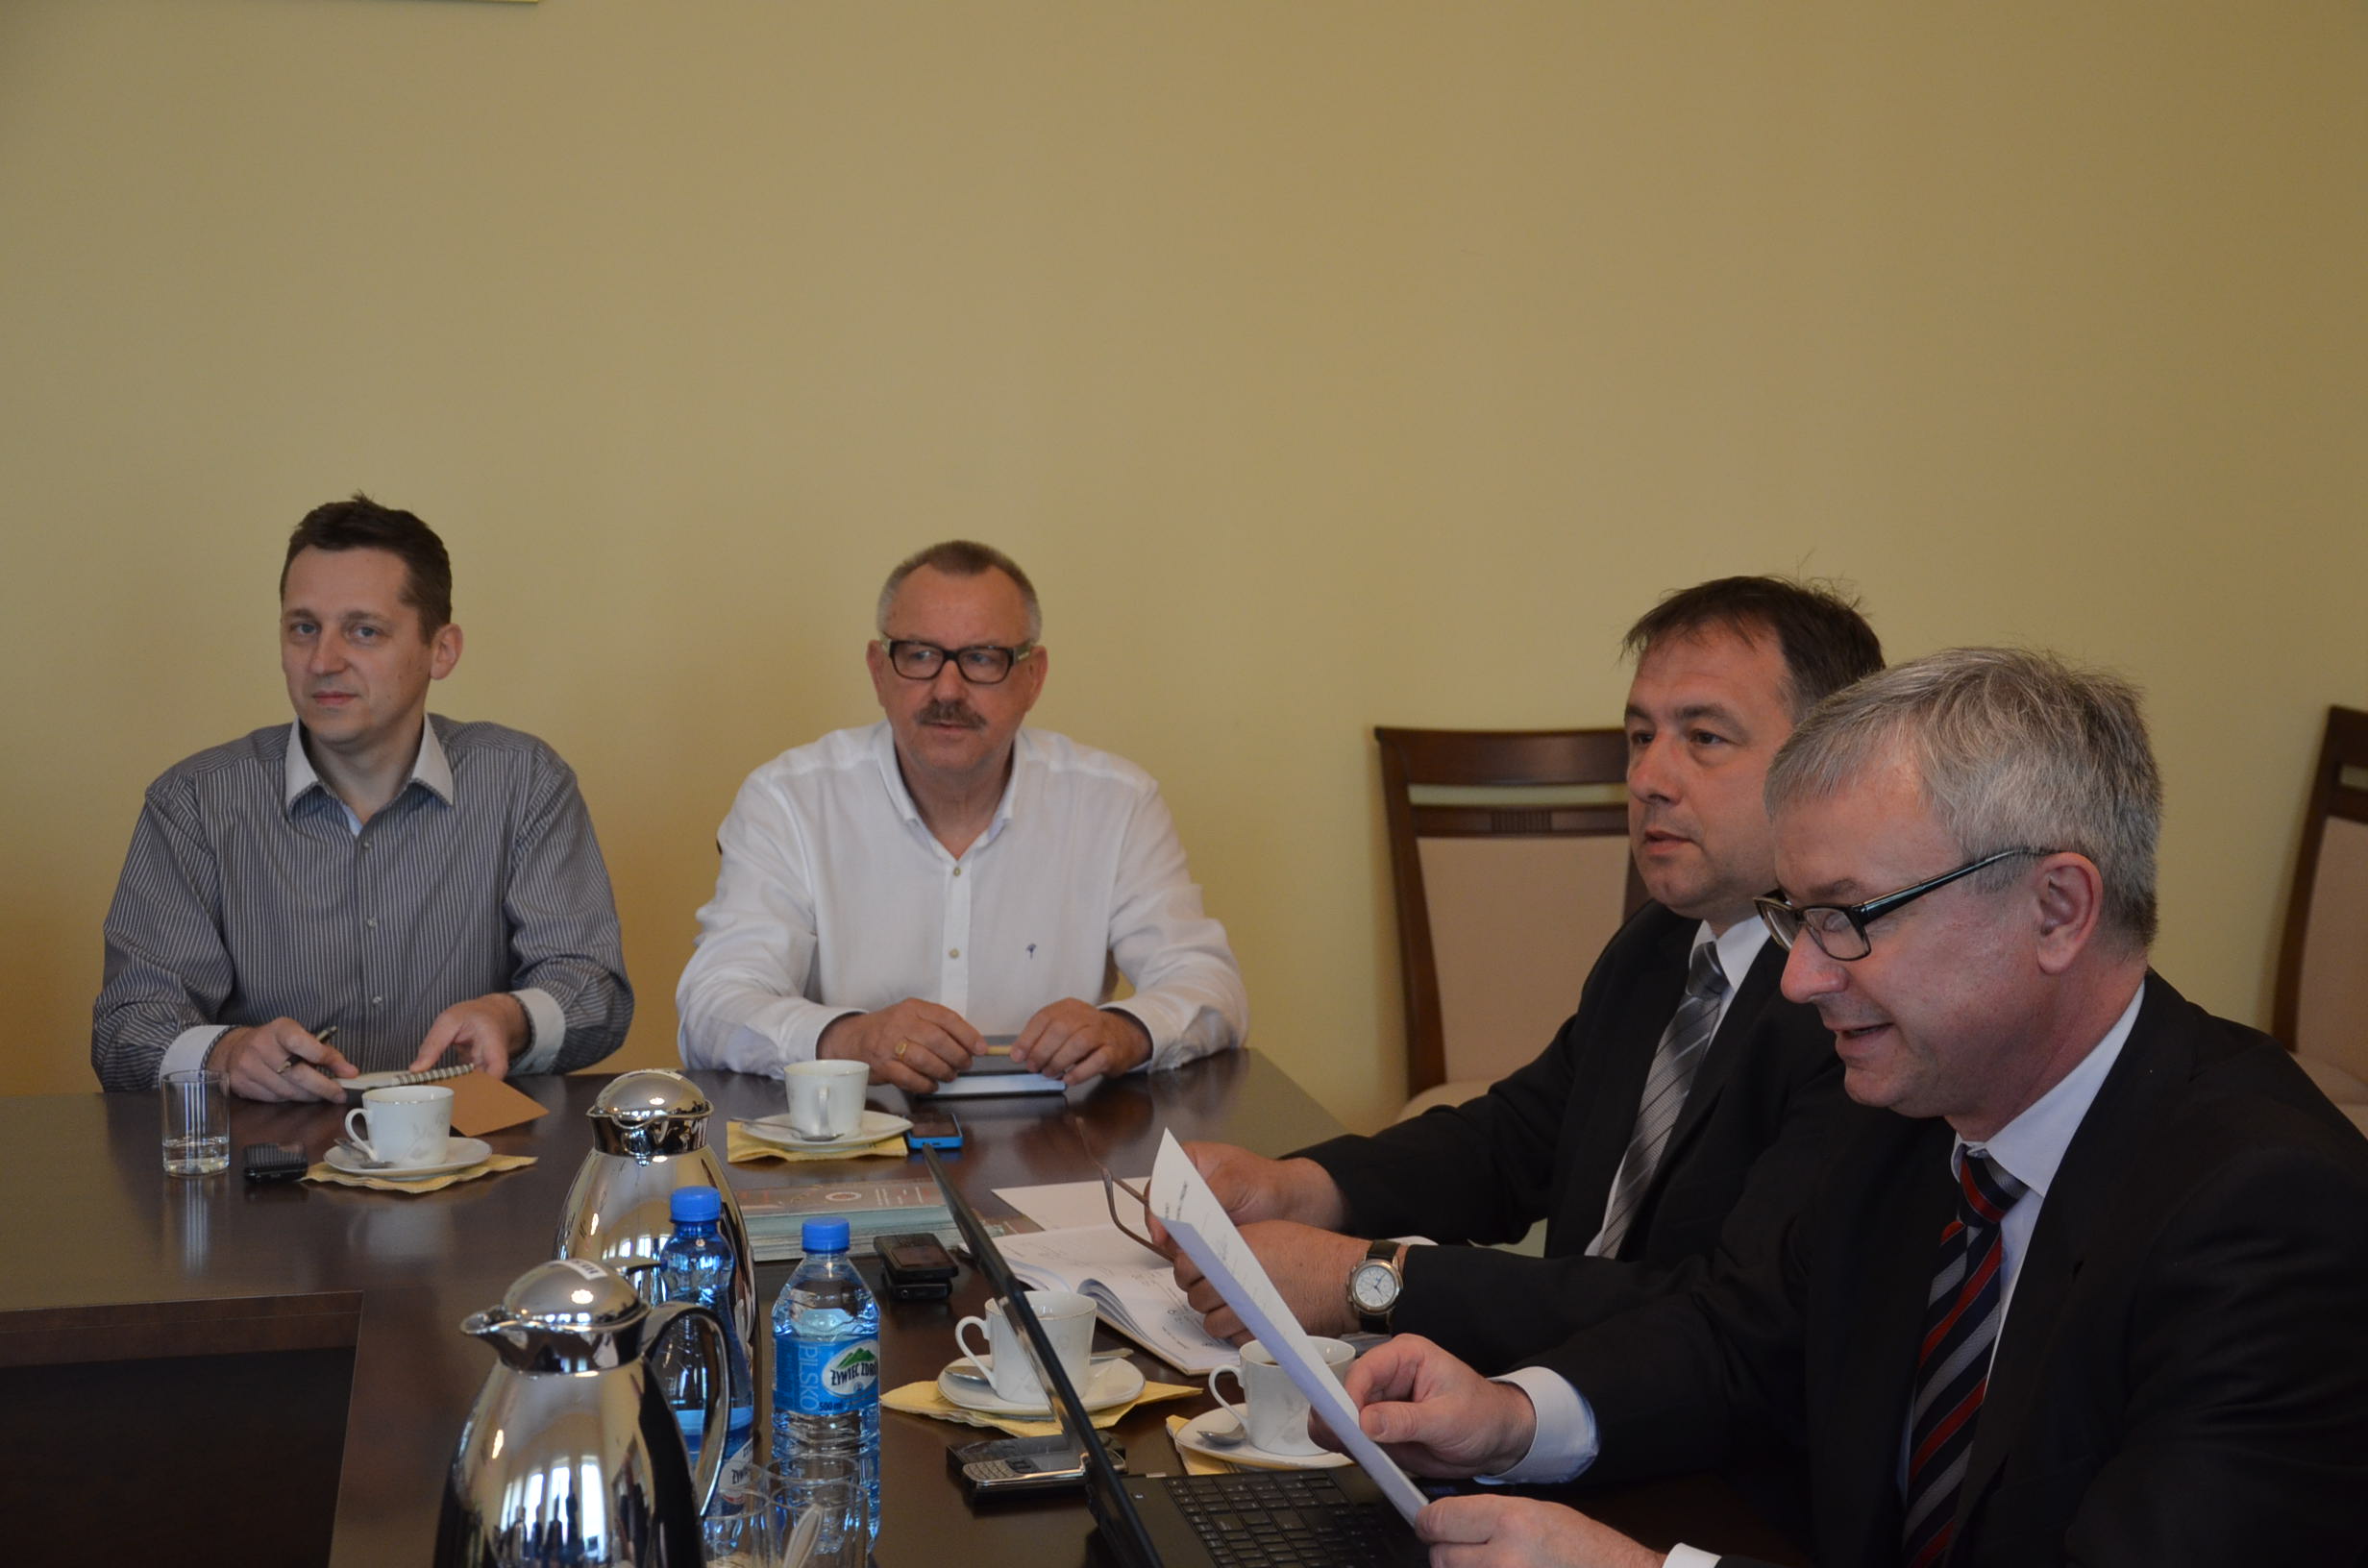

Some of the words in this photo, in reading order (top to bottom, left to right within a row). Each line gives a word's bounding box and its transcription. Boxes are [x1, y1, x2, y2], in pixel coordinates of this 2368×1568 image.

[800, 1345, 819, 1411] PILSKO
[830, 1364, 859, 1385] ŻYWIEC
[819, 1402, 832, 1411] 500
